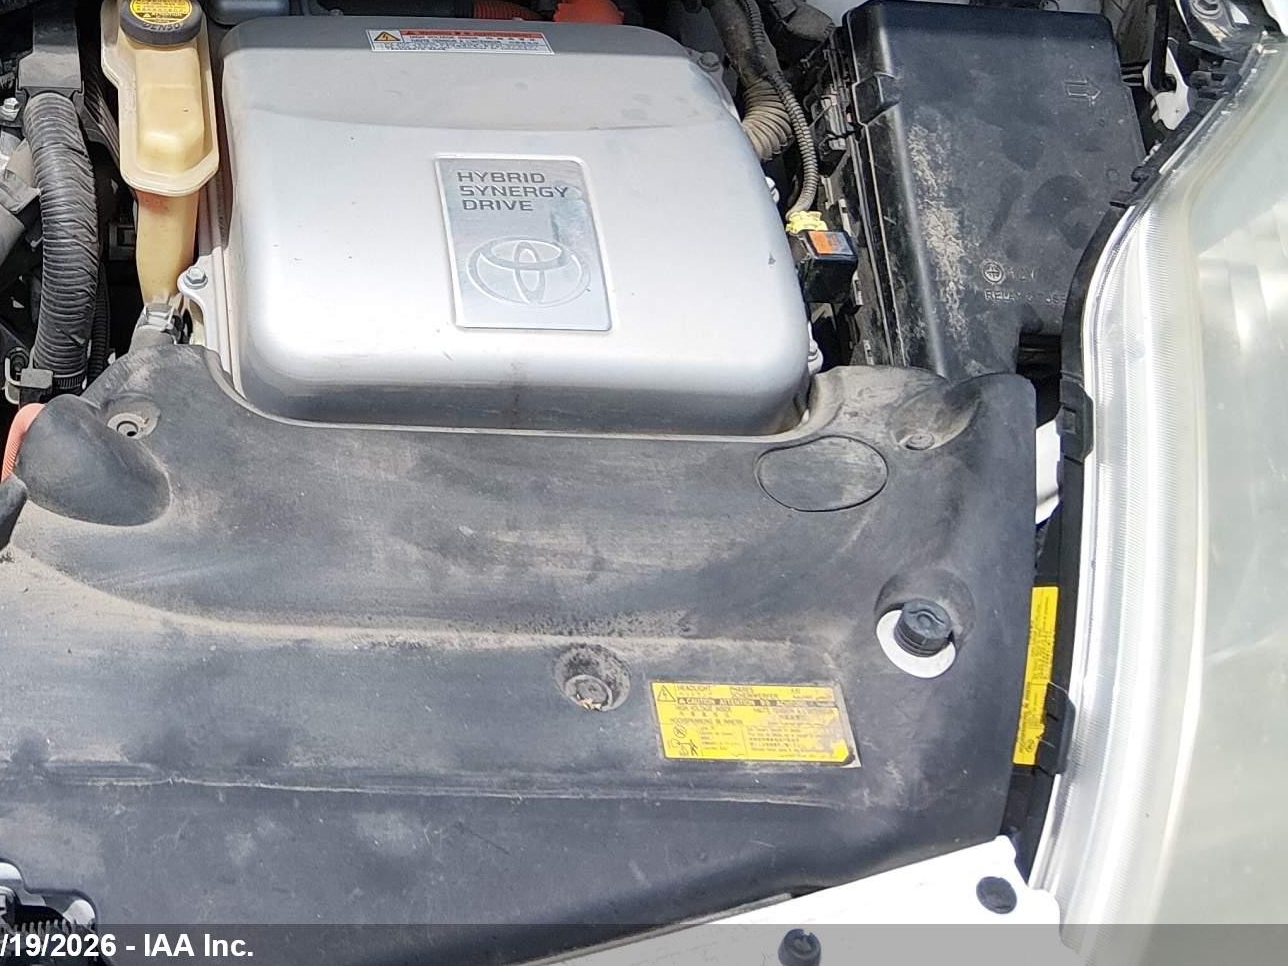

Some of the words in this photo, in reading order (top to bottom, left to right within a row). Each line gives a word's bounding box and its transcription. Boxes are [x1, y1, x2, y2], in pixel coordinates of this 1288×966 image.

[142, 22, 181, 32] DENSO
[456, 171, 545, 184] HYBRID
[460, 185, 569, 198] SYNERGY
[463, 199, 534, 212] DRIVE
